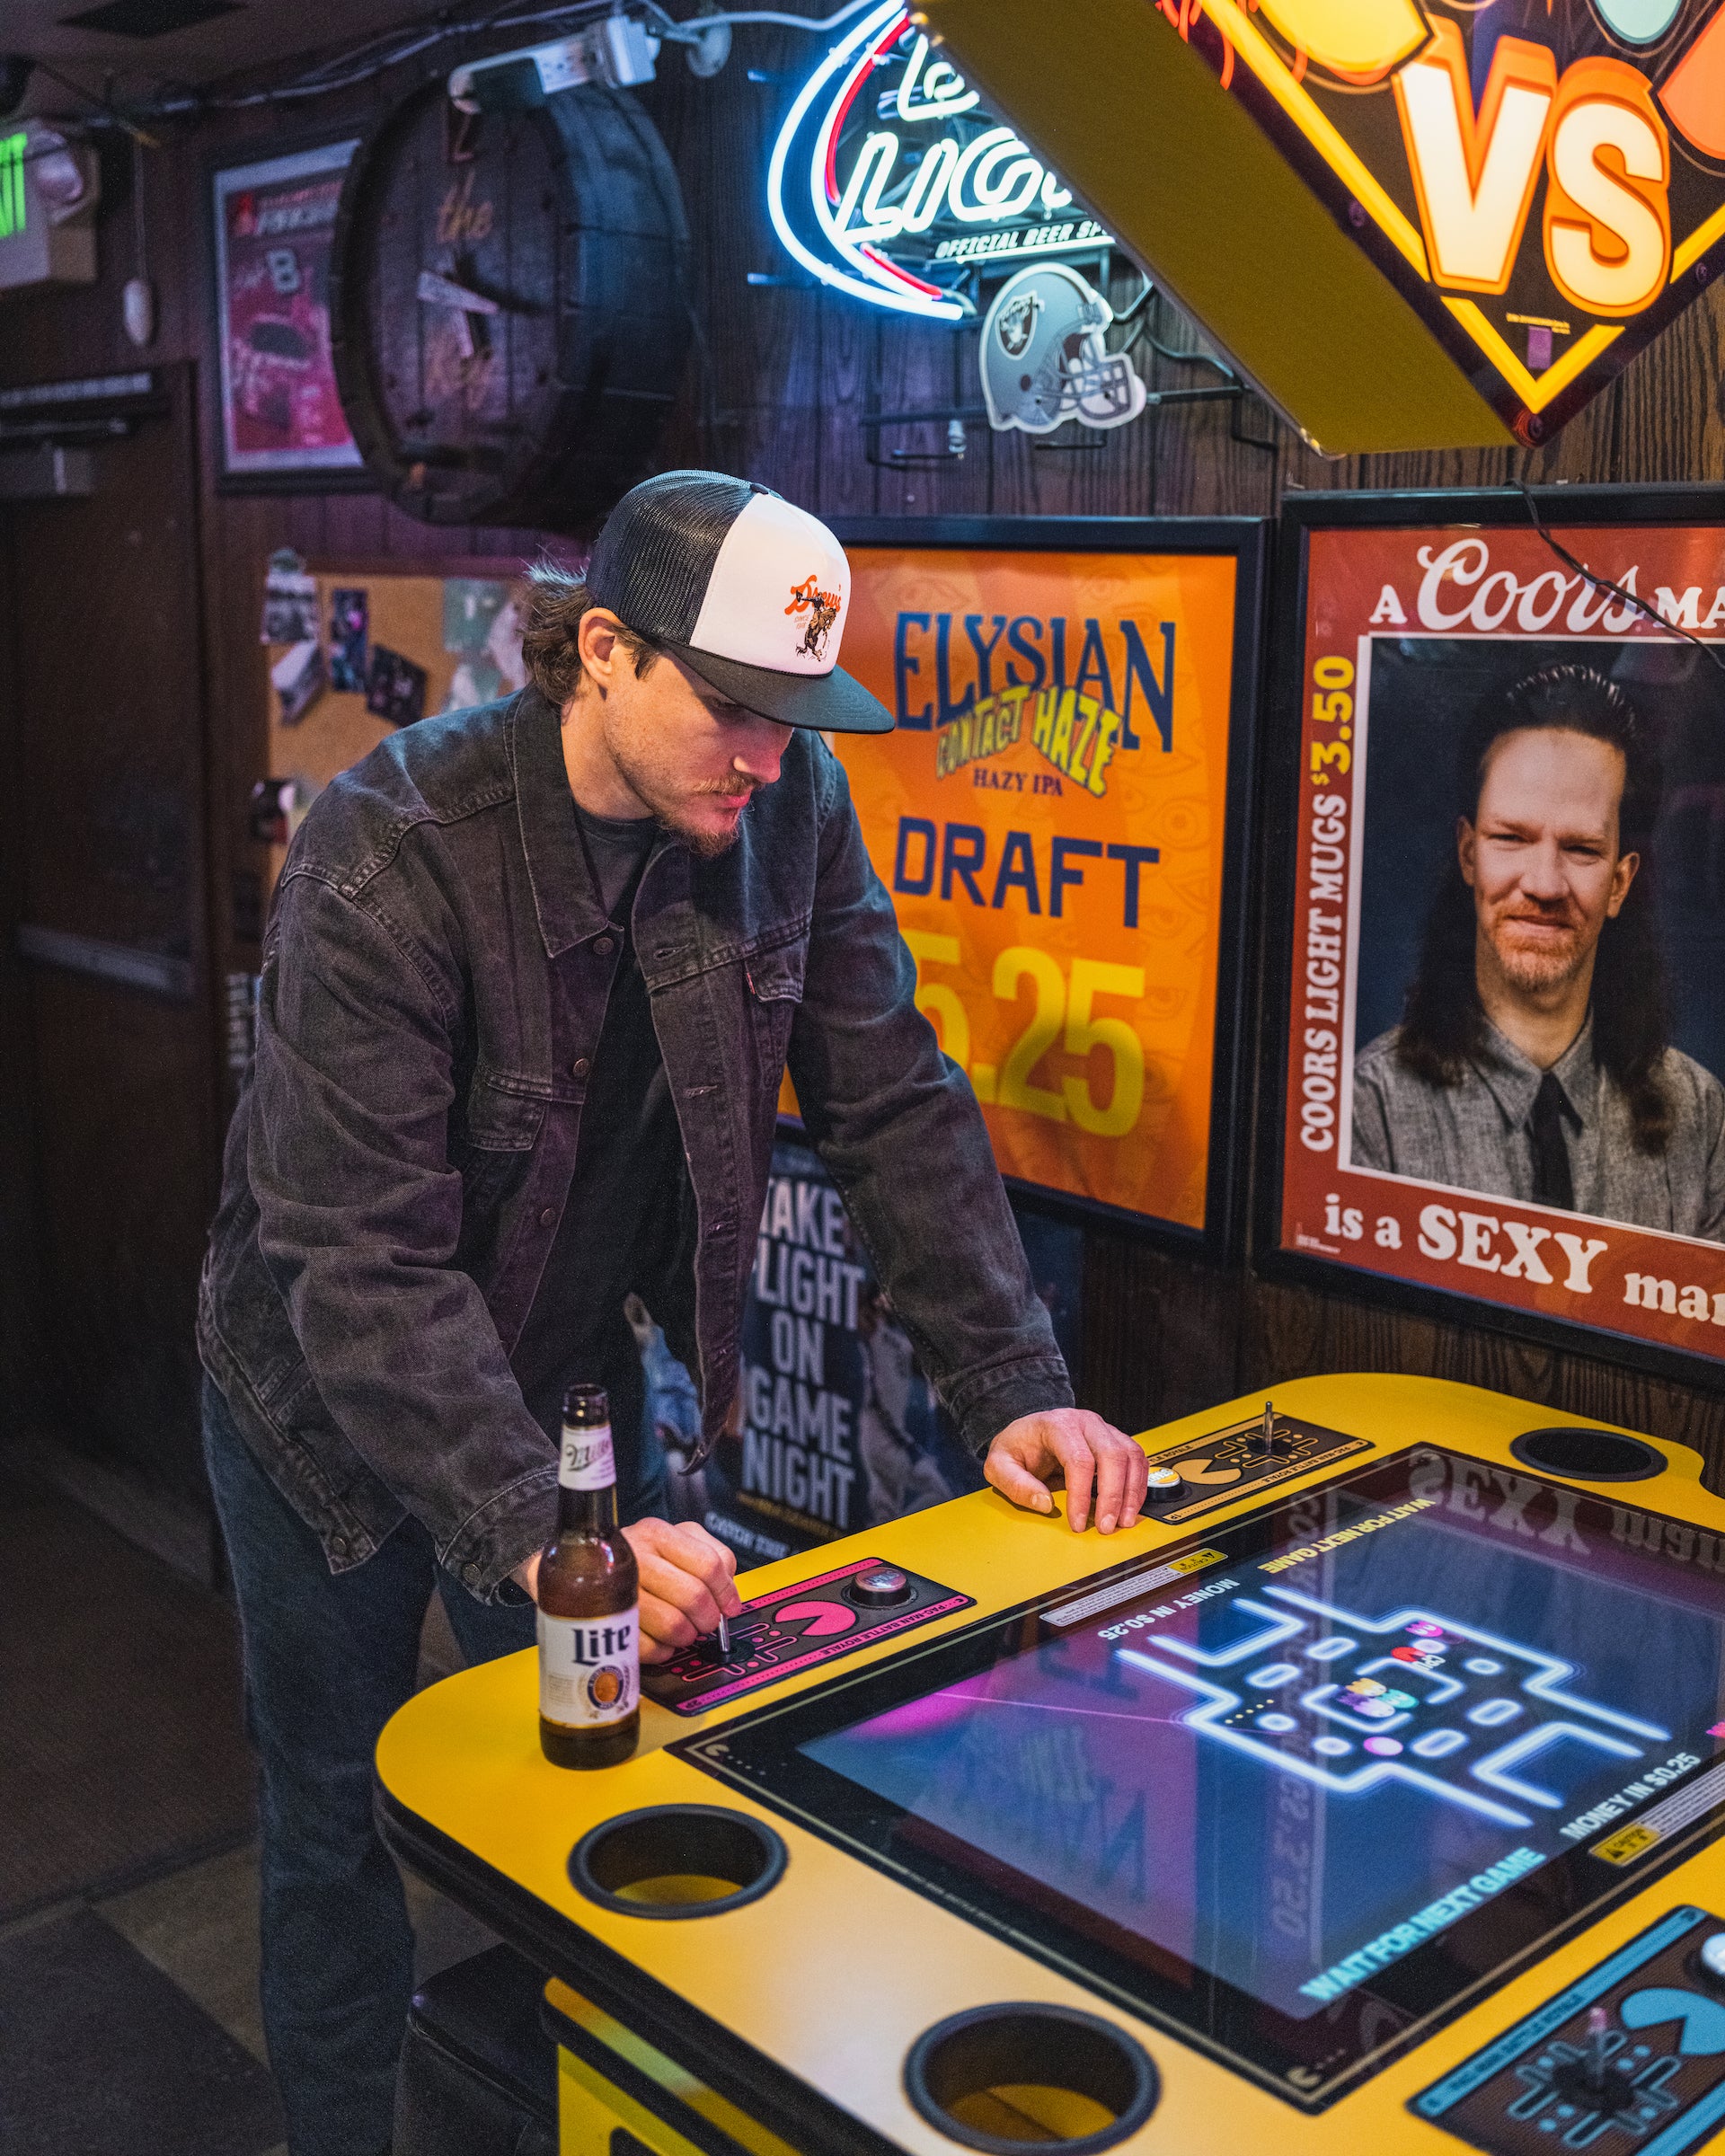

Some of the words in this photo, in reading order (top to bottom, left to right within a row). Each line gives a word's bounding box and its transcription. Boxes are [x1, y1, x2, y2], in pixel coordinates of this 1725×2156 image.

[1393, 36, 1668, 314] VS
[935, 231, 1020, 260] OFFICIAL
[1022, 222, 1075, 247] BEER
[1076, 220, 1108, 239] SP
[1369, 585, 1408, 623] A
[1417, 538, 1645, 632] Coors
[892, 611, 1175, 754] ELYSIAN
[1311, 656, 1356, 786] $3.50
[936, 685, 1031, 781] CONTACT
[1032, 685, 1123, 799] HAZE
[973, 768, 1028, 791] HAZY
[1032, 774, 1064, 796] IPA
[897, 816, 1160, 928] DRAFT
[1308, 793, 1348, 902] MUGS
[1305, 907, 1343, 1023] LIGHT
[1300, 1029, 1339, 1152] COORS
[753, 1238, 865, 1330] LIGHT
[1323, 1194, 1364, 1241] is
[1375, 1215, 1402, 1250] a
[1418, 1205, 1608, 1294] SEXY
[771, 1312, 825, 1387] ON
[748, 1365, 853, 1462] GAME
[742, 1430, 856, 1528] NIGHT
[1387, 1498, 1437, 1519] WAIT
[1257, 1547, 1319, 1574] GAME
[1312, 1528, 1364, 1553] NEXT
[1358, 1514, 1395, 1533] FOR
[863, 1620, 900, 1640] BATTLE
[900, 1604, 947, 1625] PAC-MAN
[1097, 1614, 1155, 1640] $0.25
[1149, 1605, 1177, 1618] IN
[1173, 1578, 1241, 1609] MONEY
[571, 1625, 631, 1666] Lite
[820, 1634, 863, 1656] ROYALE
[1560, 1794, 1633, 1840] MONEY
[1623, 1782, 1655, 1798] IN
[1643, 1753, 1701, 1786] $0.25
[1299, 1950, 1377, 2001] WAIT
[1363, 1922, 1430, 1962] FOR
[1410, 1885, 1482, 1931] NEXT
[1469, 1846, 1546, 1893] GAME
